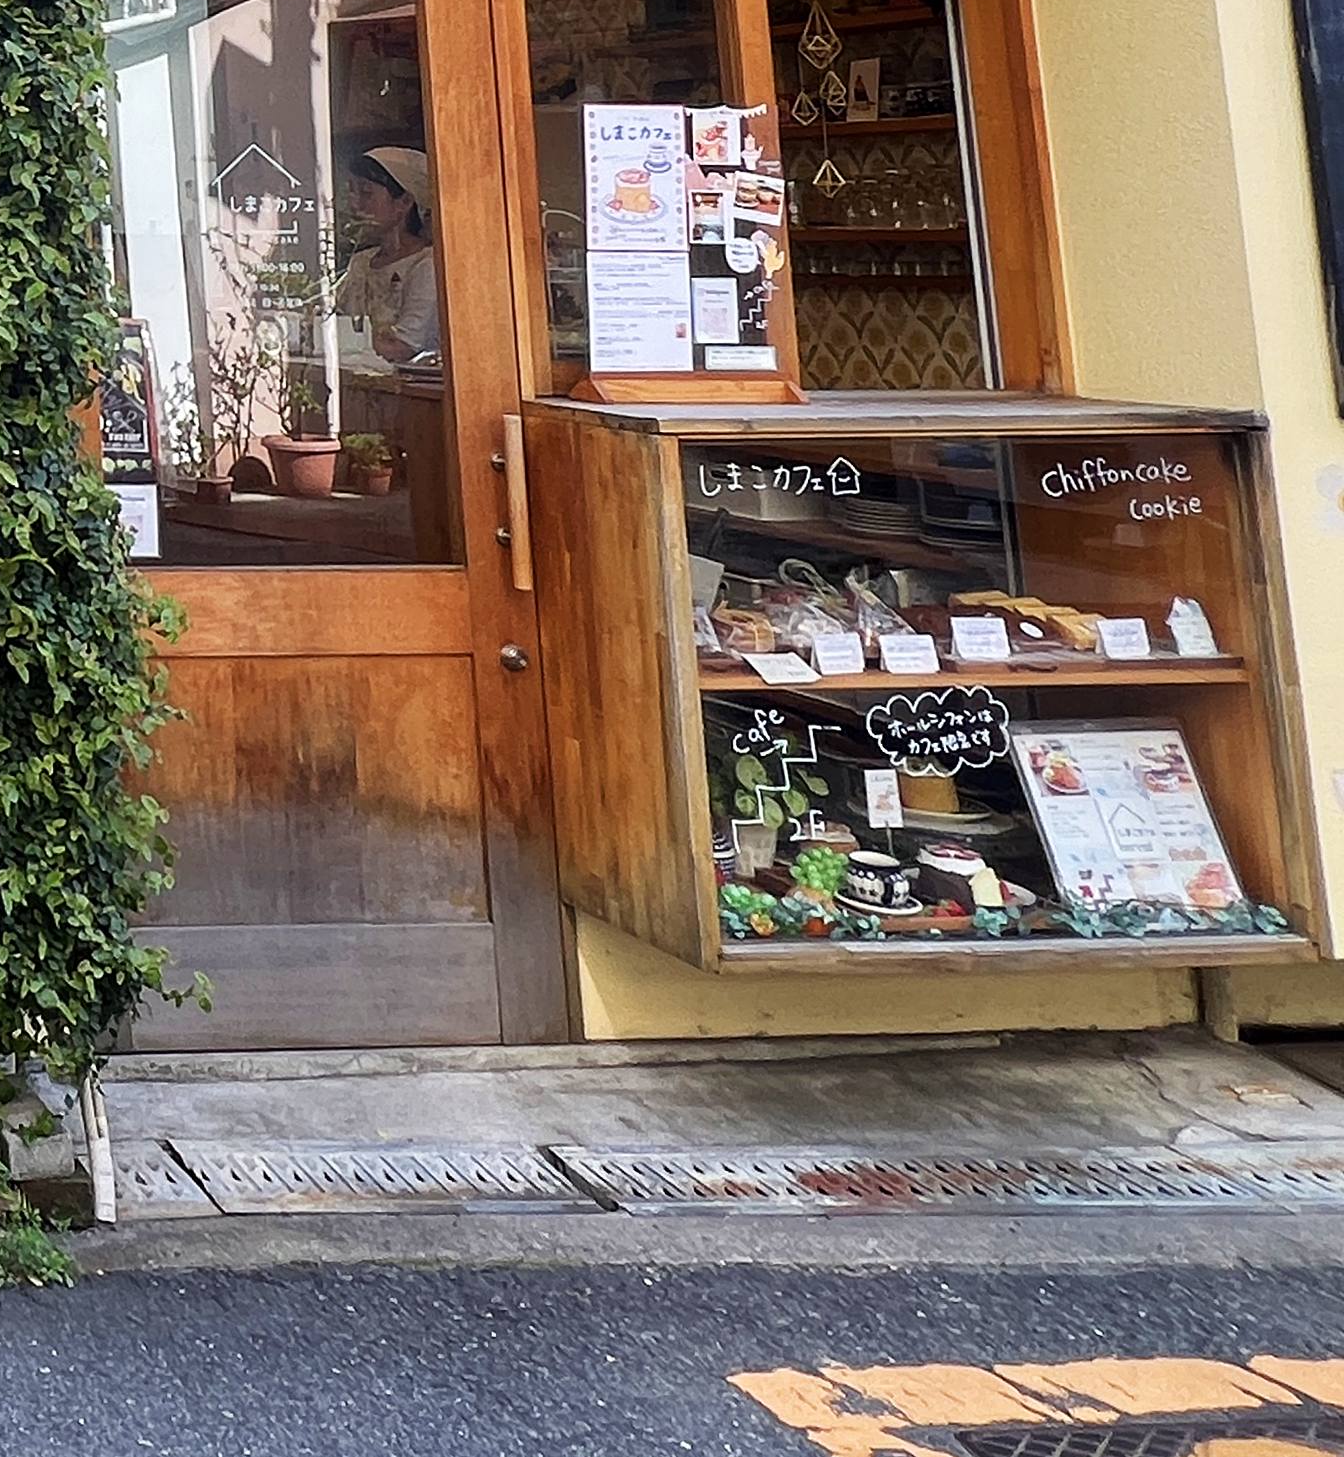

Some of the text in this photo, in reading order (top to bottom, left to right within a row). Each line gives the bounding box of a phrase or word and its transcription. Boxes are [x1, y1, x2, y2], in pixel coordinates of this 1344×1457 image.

[600, 125, 672, 142] しまこカフェ
[699, 463, 825, 498] しまこカフェ
